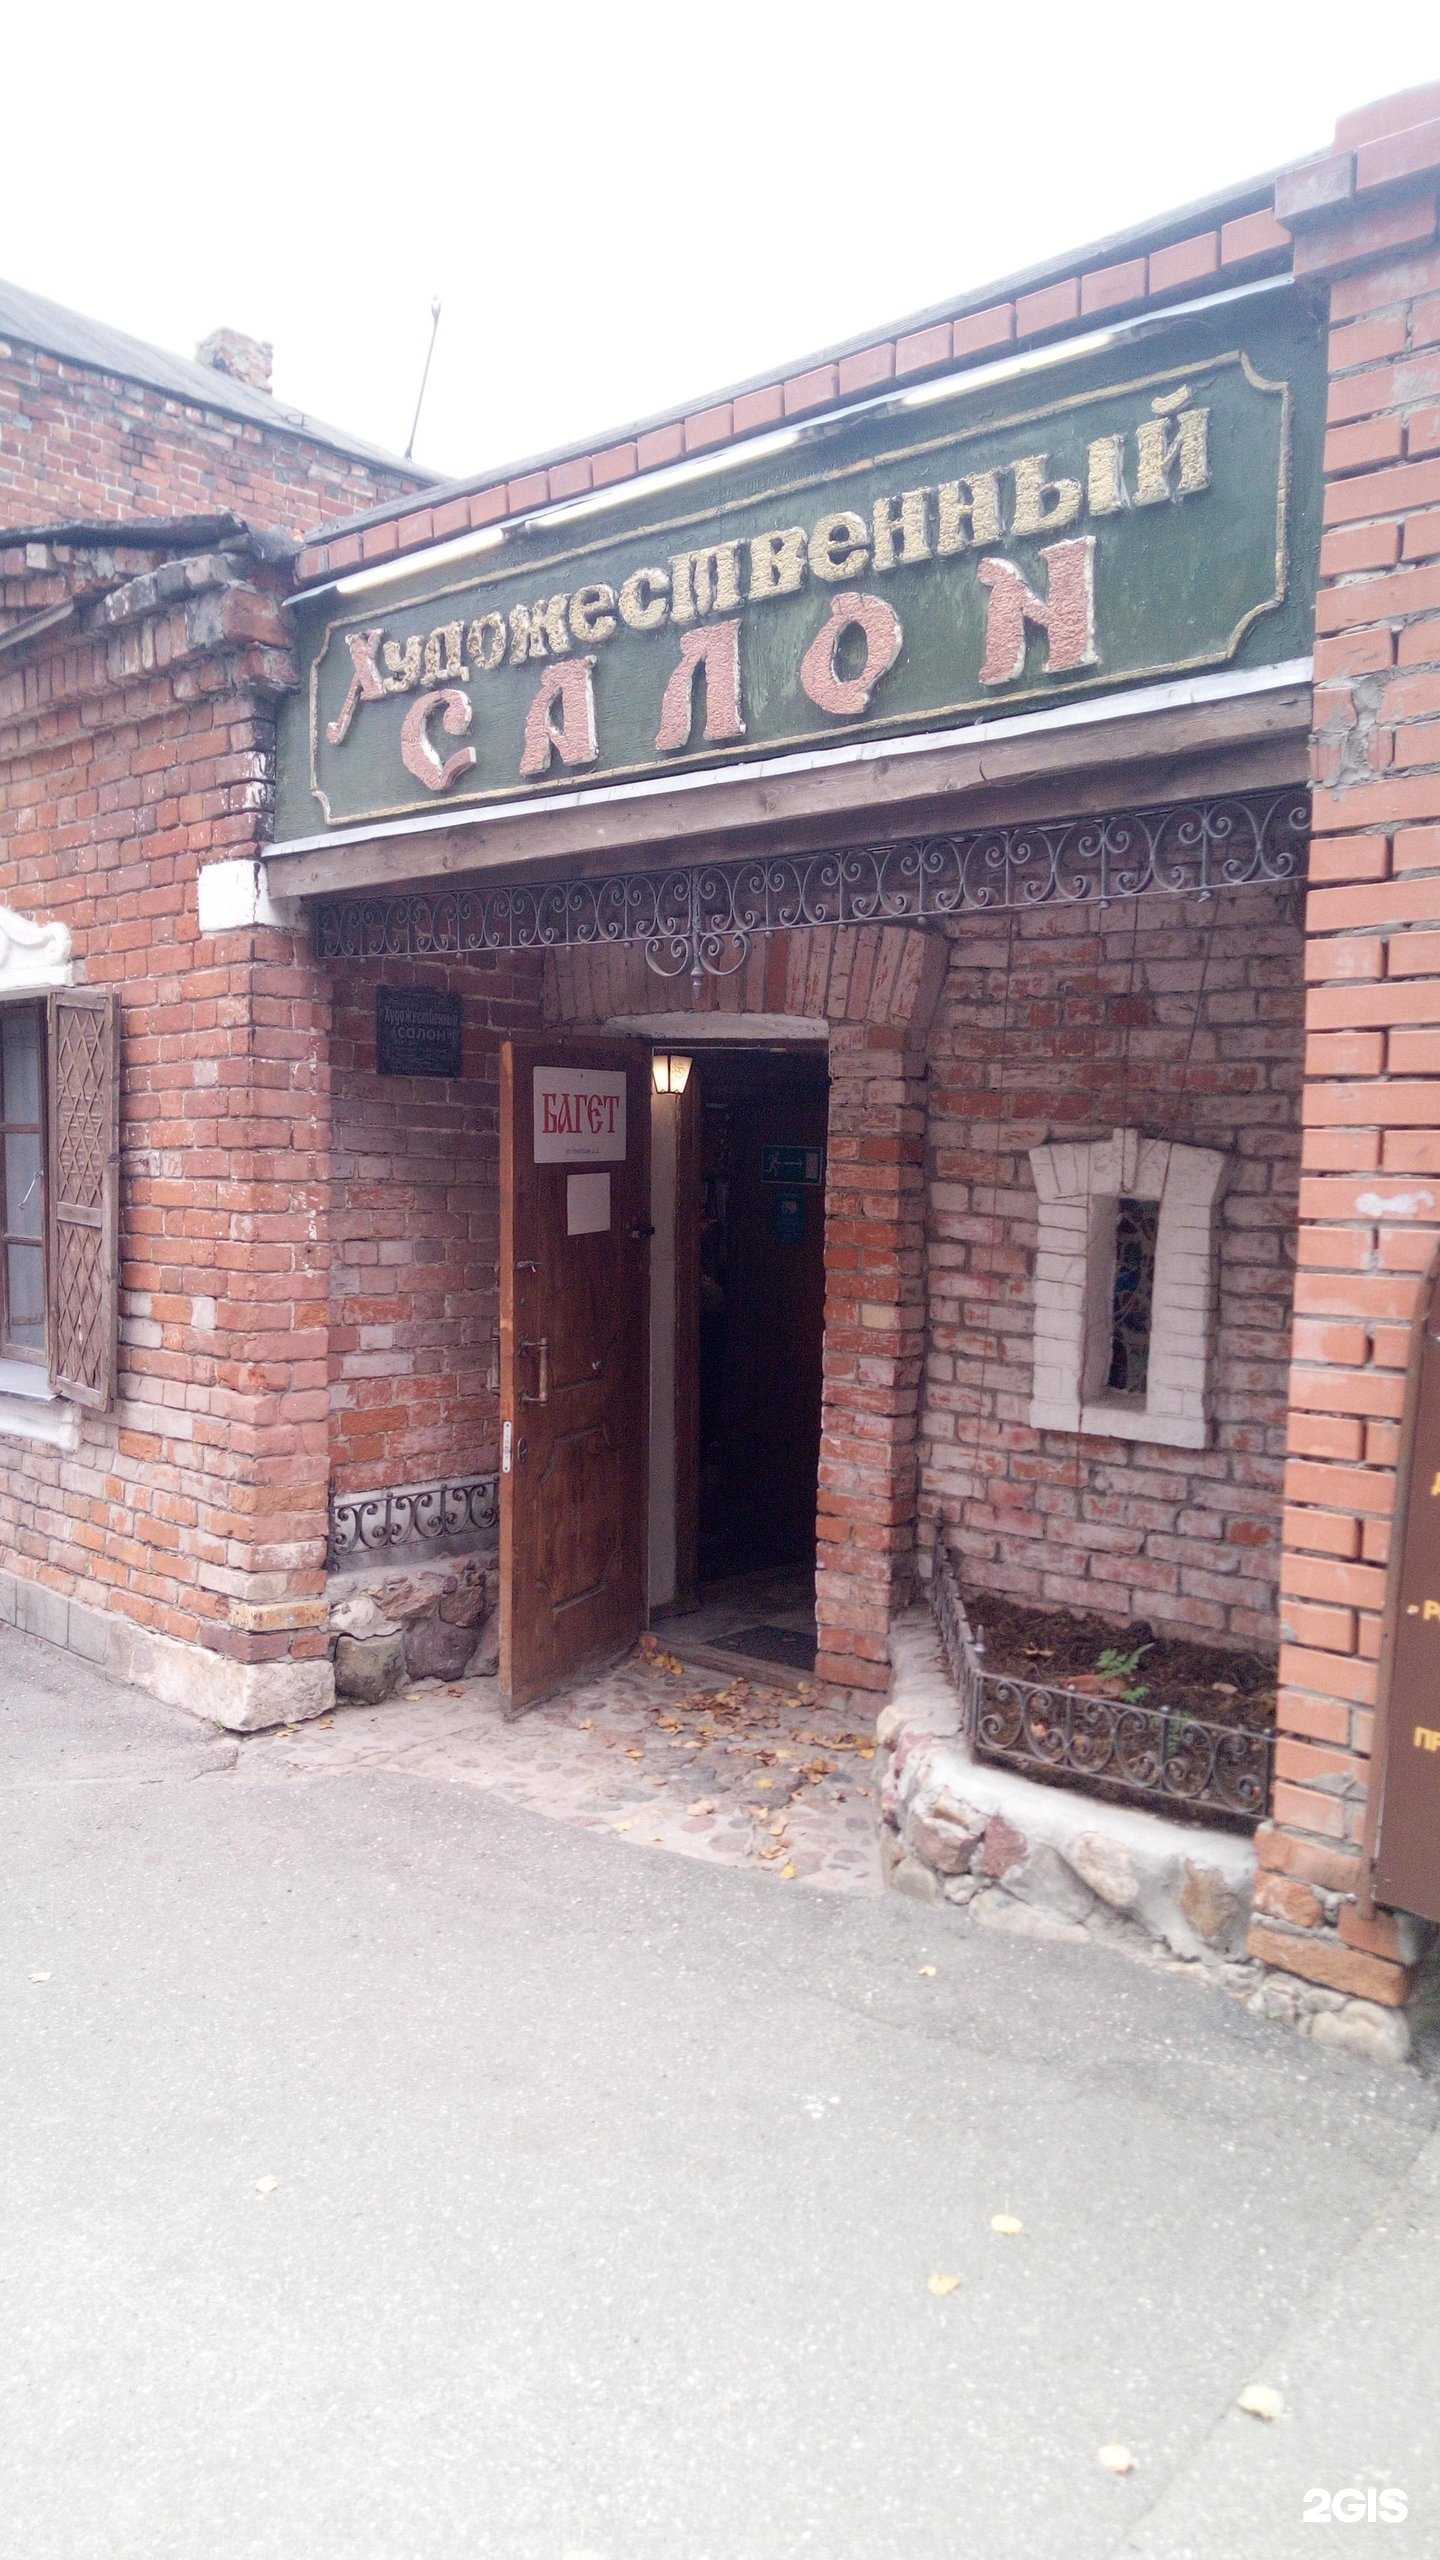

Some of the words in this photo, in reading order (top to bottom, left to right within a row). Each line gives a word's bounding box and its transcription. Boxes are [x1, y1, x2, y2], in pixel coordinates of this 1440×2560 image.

[326, 383, 1211, 746] Художественный
[400, 535, 1102, 791] САЛОН
[541, 1092, 620, 1135] БАГЕТ
